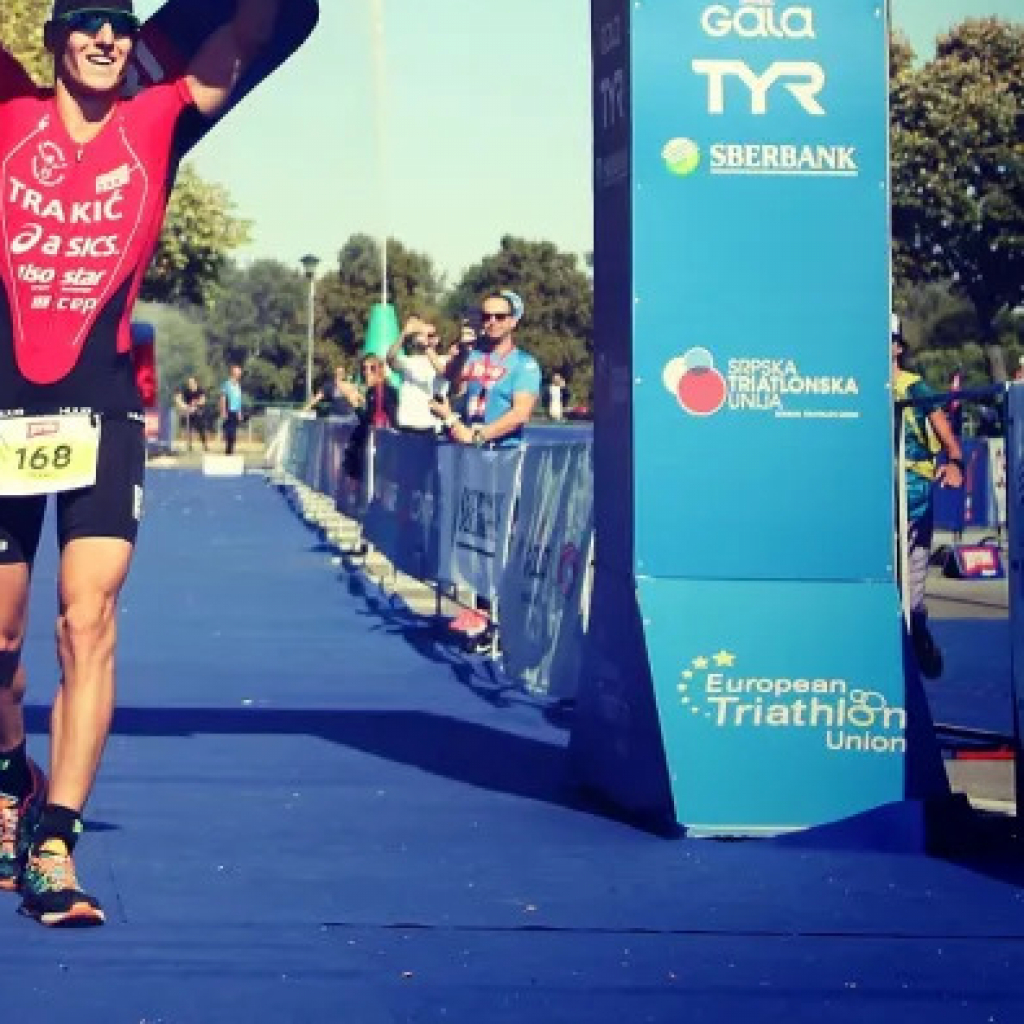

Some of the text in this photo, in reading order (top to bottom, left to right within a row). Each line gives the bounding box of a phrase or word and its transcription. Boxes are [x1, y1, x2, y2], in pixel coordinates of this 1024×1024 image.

[699, 4, 817, 38] Gala
[690, 59, 826, 115] TYR
[709, 144, 858, 170] SBERBANK
[15, 443, 73, 470] 168
[705, 672, 846, 697] European
[706, 696, 907, 730] Triathlon
[825, 729, 907, 753] Union
